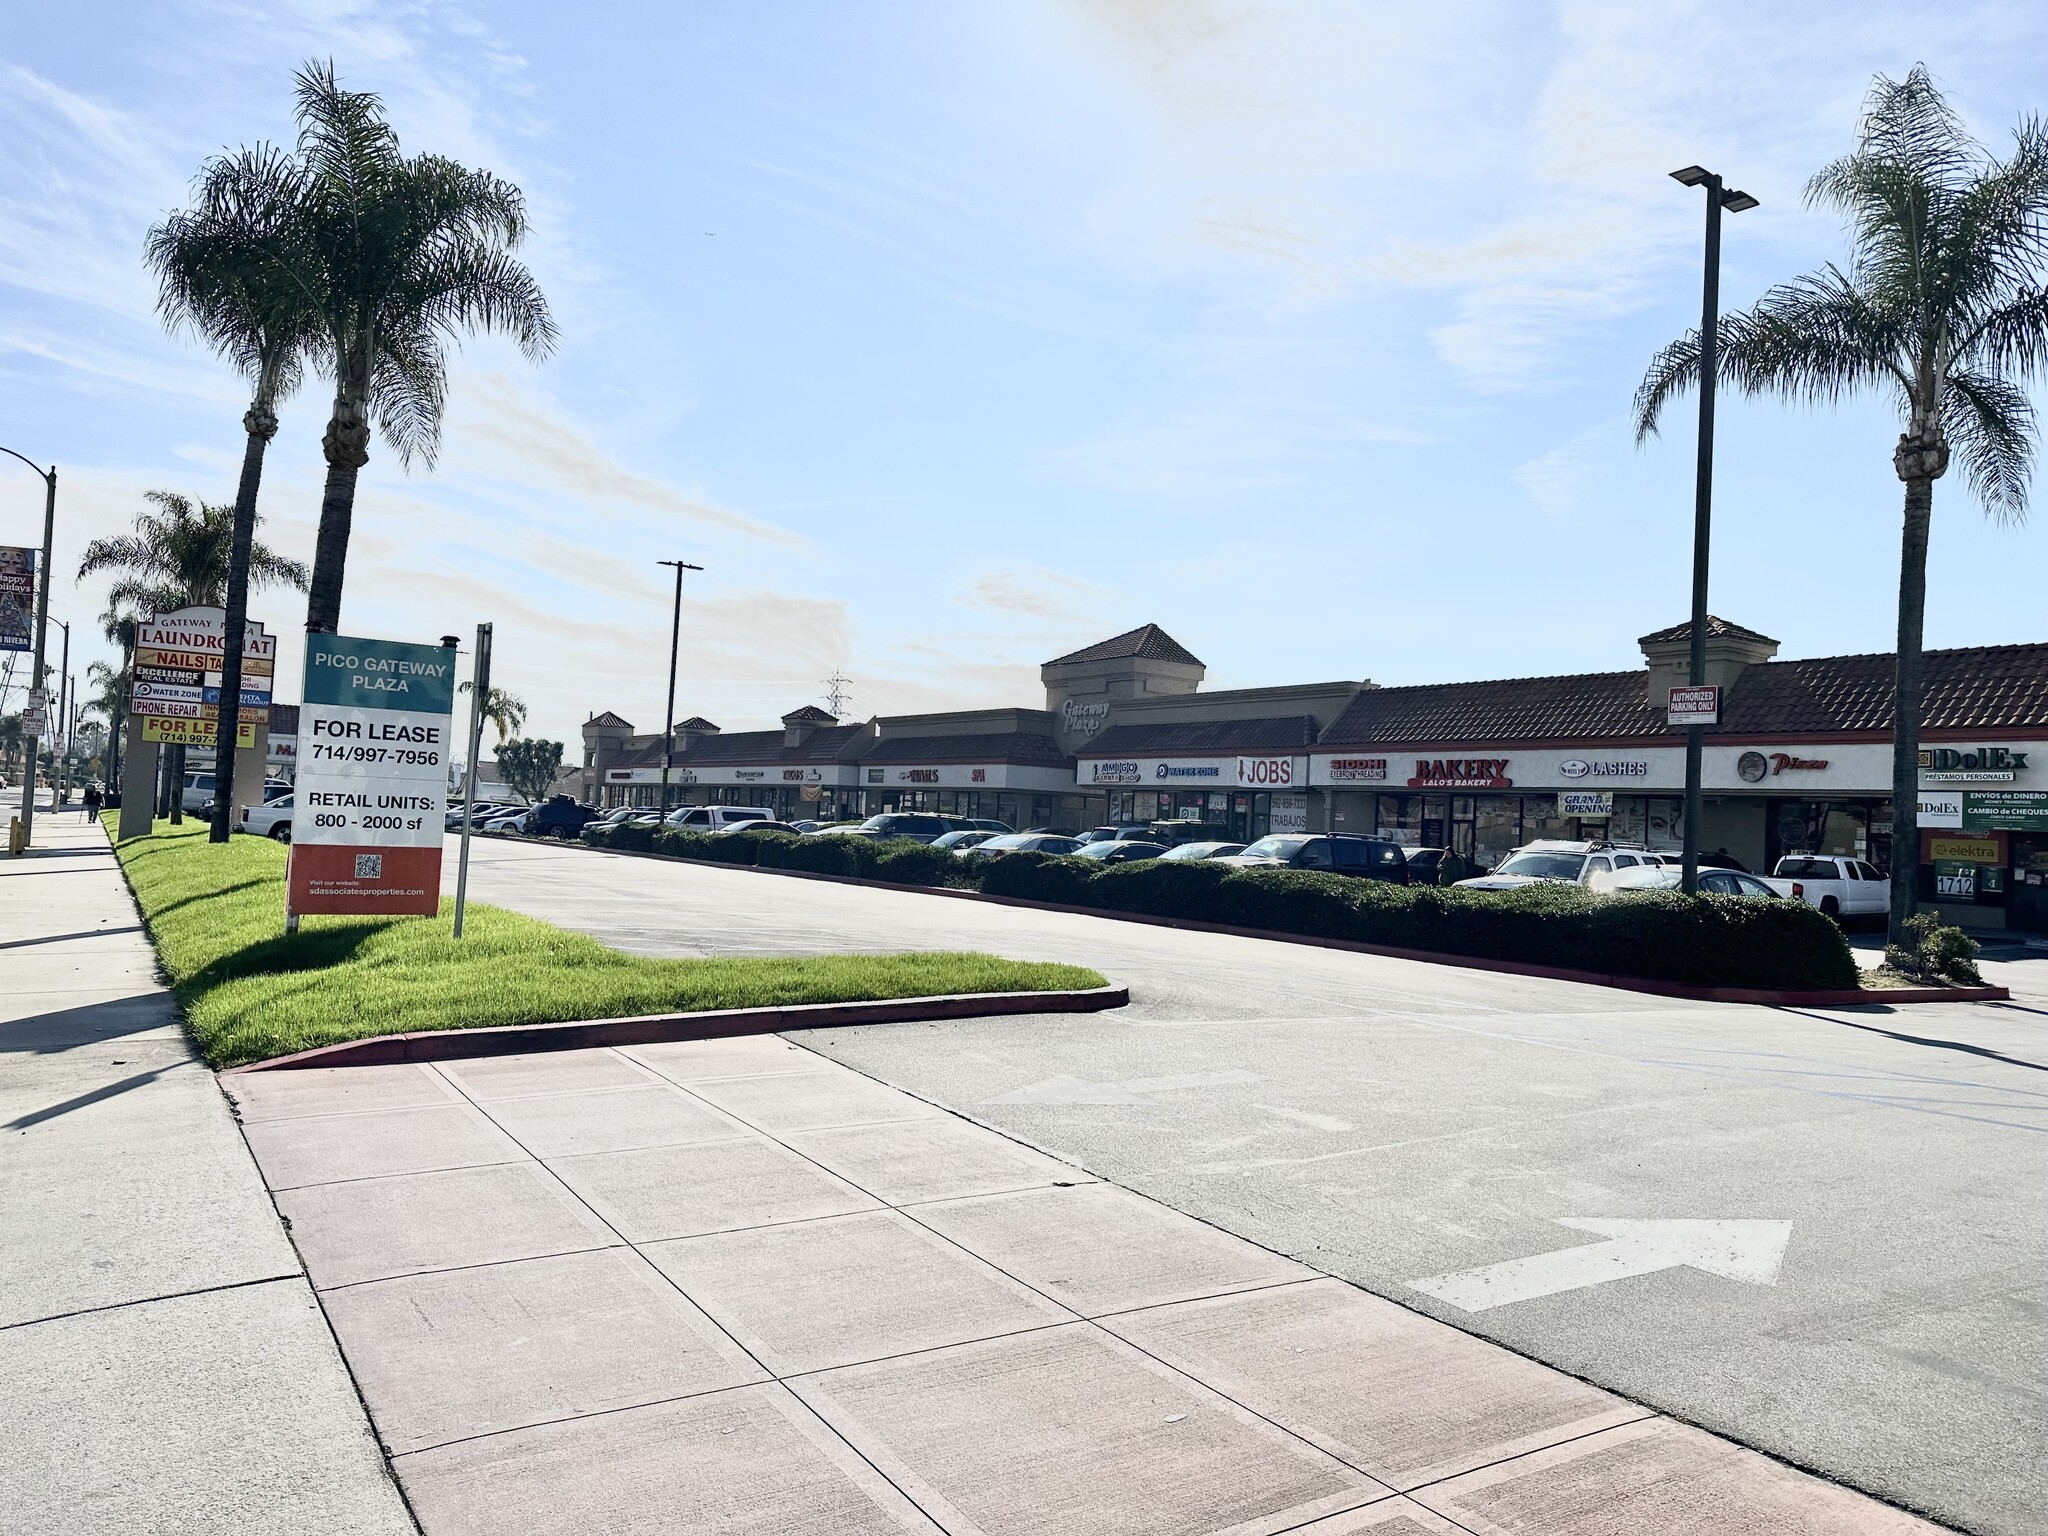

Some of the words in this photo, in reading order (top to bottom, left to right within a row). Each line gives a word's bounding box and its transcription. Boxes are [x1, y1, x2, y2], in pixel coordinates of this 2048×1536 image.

[0, 582, 31, 593] olidays
[161, 618, 212, 628] GATEWAY
[4, 635, 28, 645] RIVERA
[156, 652, 206, 669] NAILS
[315, 652, 359, 669] PICO
[364, 657, 447, 678] GATEWAY
[136, 666, 199, 680] EXCELLENCE
[141, 674, 163, 682] REAL
[165, 676, 195, 685] ESTATE
[352, 675, 409, 692] PLAZA
[152, 687, 179, 697] WATER
[181, 690, 202, 699] ZONE
[1672, 691, 1714, 702] AUTHORIZED
[24, 709, 33, 717] NO
[133, 701, 165, 714] IPHONE
[167, 703, 198, 717] REPAIR
[1062, 699, 1109, 718] Gateway
[1670, 702, 1697, 712] PARKING
[1698, 701, 1715, 711] ONLY
[148, 718, 187, 734] FOR
[193, 721, 250, 737] LEE
[313, 719, 362, 739] FOR
[368, 723, 440, 744] LEASE
[1063, 715, 1099, 737] Plaza
[160, 732, 187, 742] (714)
[312, 744, 439, 766] 714/997-7956
[1933, 747, 2029, 770] DolEx
[1101, 763, 1138, 774] AMIGO
[1330, 759, 1386, 769] SIDDHI
[1415, 759, 1510, 779] BAKERY
[1591, 762, 1647, 776] LASHES
[1769, 753, 1829, 776] Pizza
[971, 768, 986, 783] SPA
[1095, 774, 1120, 783] BARBER
[1121, 774, 1141, 783] SHOP
[1168, 767, 1194, 776] WATER
[1195, 767, 1219, 777] ZONE
[1247, 760, 1291, 785] JOBS
[1422, 779, 1453, 787] LALO'S
[1454, 779, 1493, 787] BAKERY
[308, 792, 373, 808] RETAIL
[377, 795, 435, 811] UNITS:
[1564, 795, 1603, 805] GRAND
[1970, 791, 2001, 799] ENVÍOS
[2002, 792, 2012, 800] de
[1564, 804, 1612, 813] OPENING
[1924, 802, 1959, 814] DolEx
[1967, 807, 1999, 815] CAMBIO
[315, 813, 347, 828] 800
[362, 815, 403, 830] 2000
[406, 817, 423, 831] sf
[1270, 814, 1307, 828] TRABAJOS
[1949, 844, 1995, 857] elektra
[308, 887, 424, 897] sdassociatesproperties.com
[1938, 878, 1973, 895] 1712
